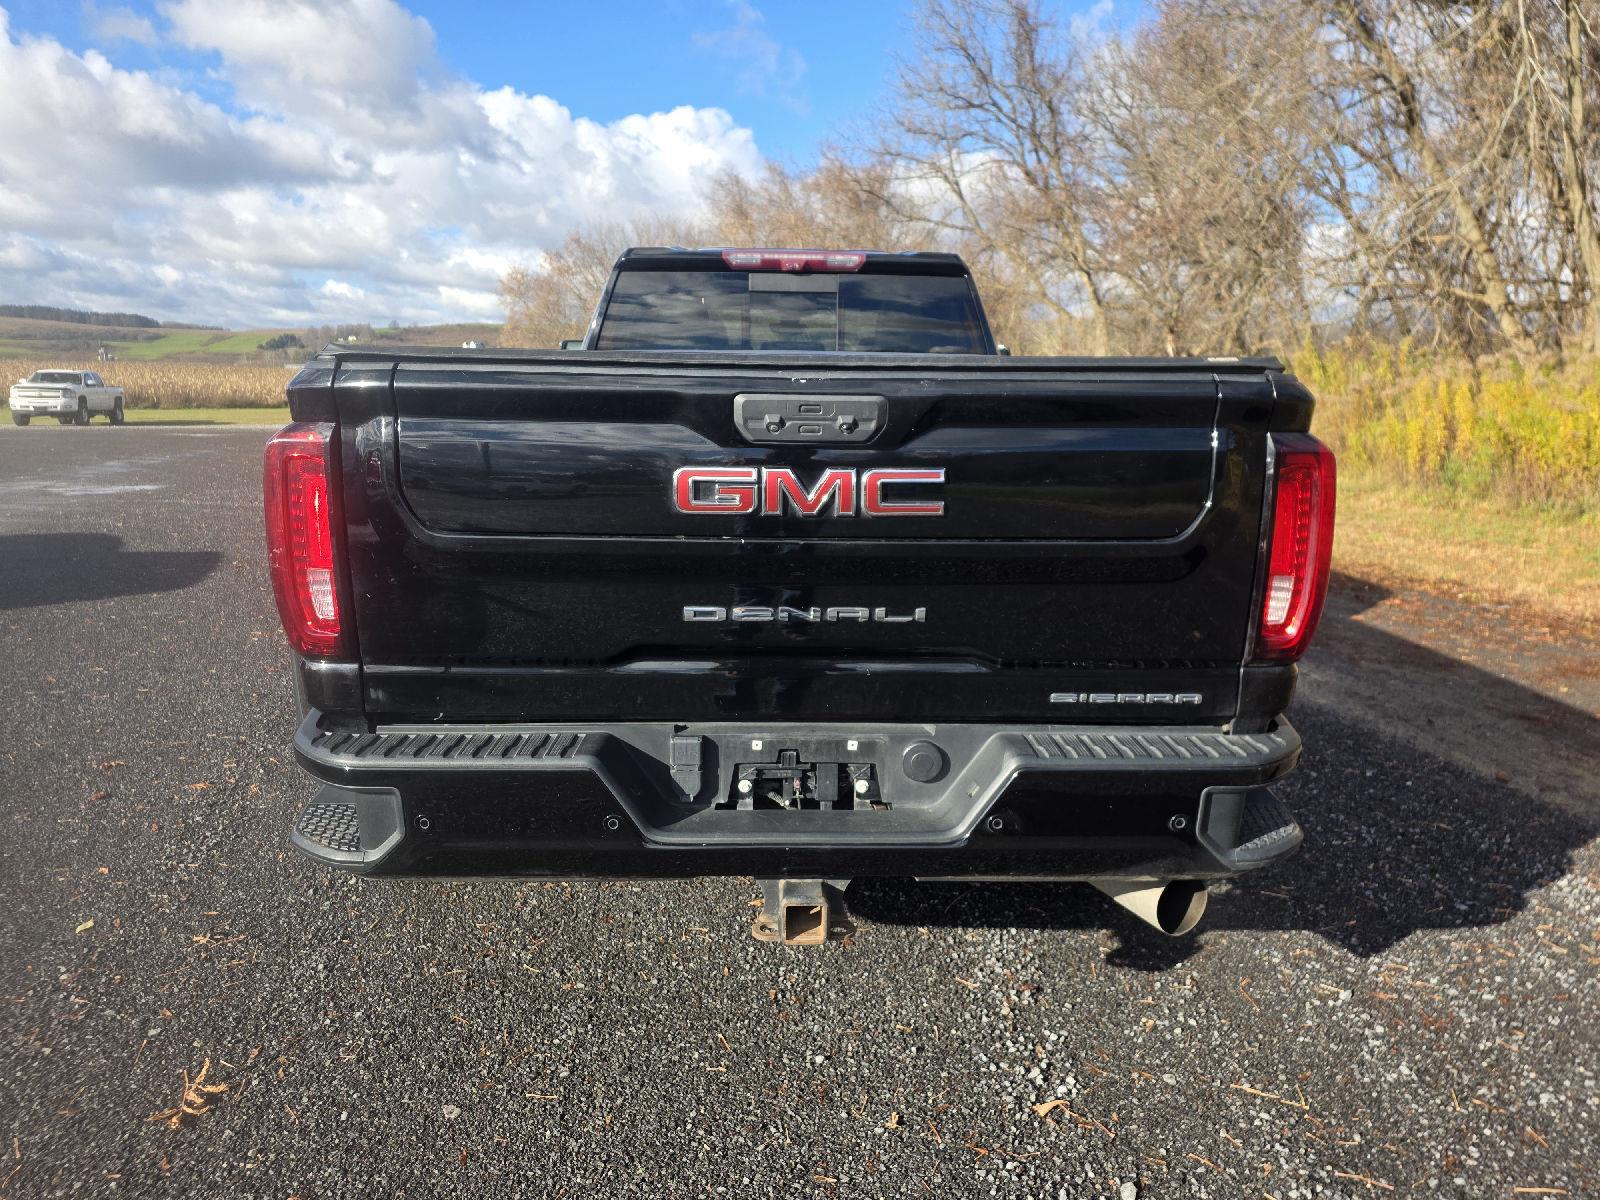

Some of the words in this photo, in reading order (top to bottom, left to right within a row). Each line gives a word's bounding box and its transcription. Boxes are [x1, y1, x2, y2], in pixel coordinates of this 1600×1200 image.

[672, 466, 946, 517] GMC
[682, 606, 926, 623] DENALI
[1050, 692, 1203, 705] SIERRA
